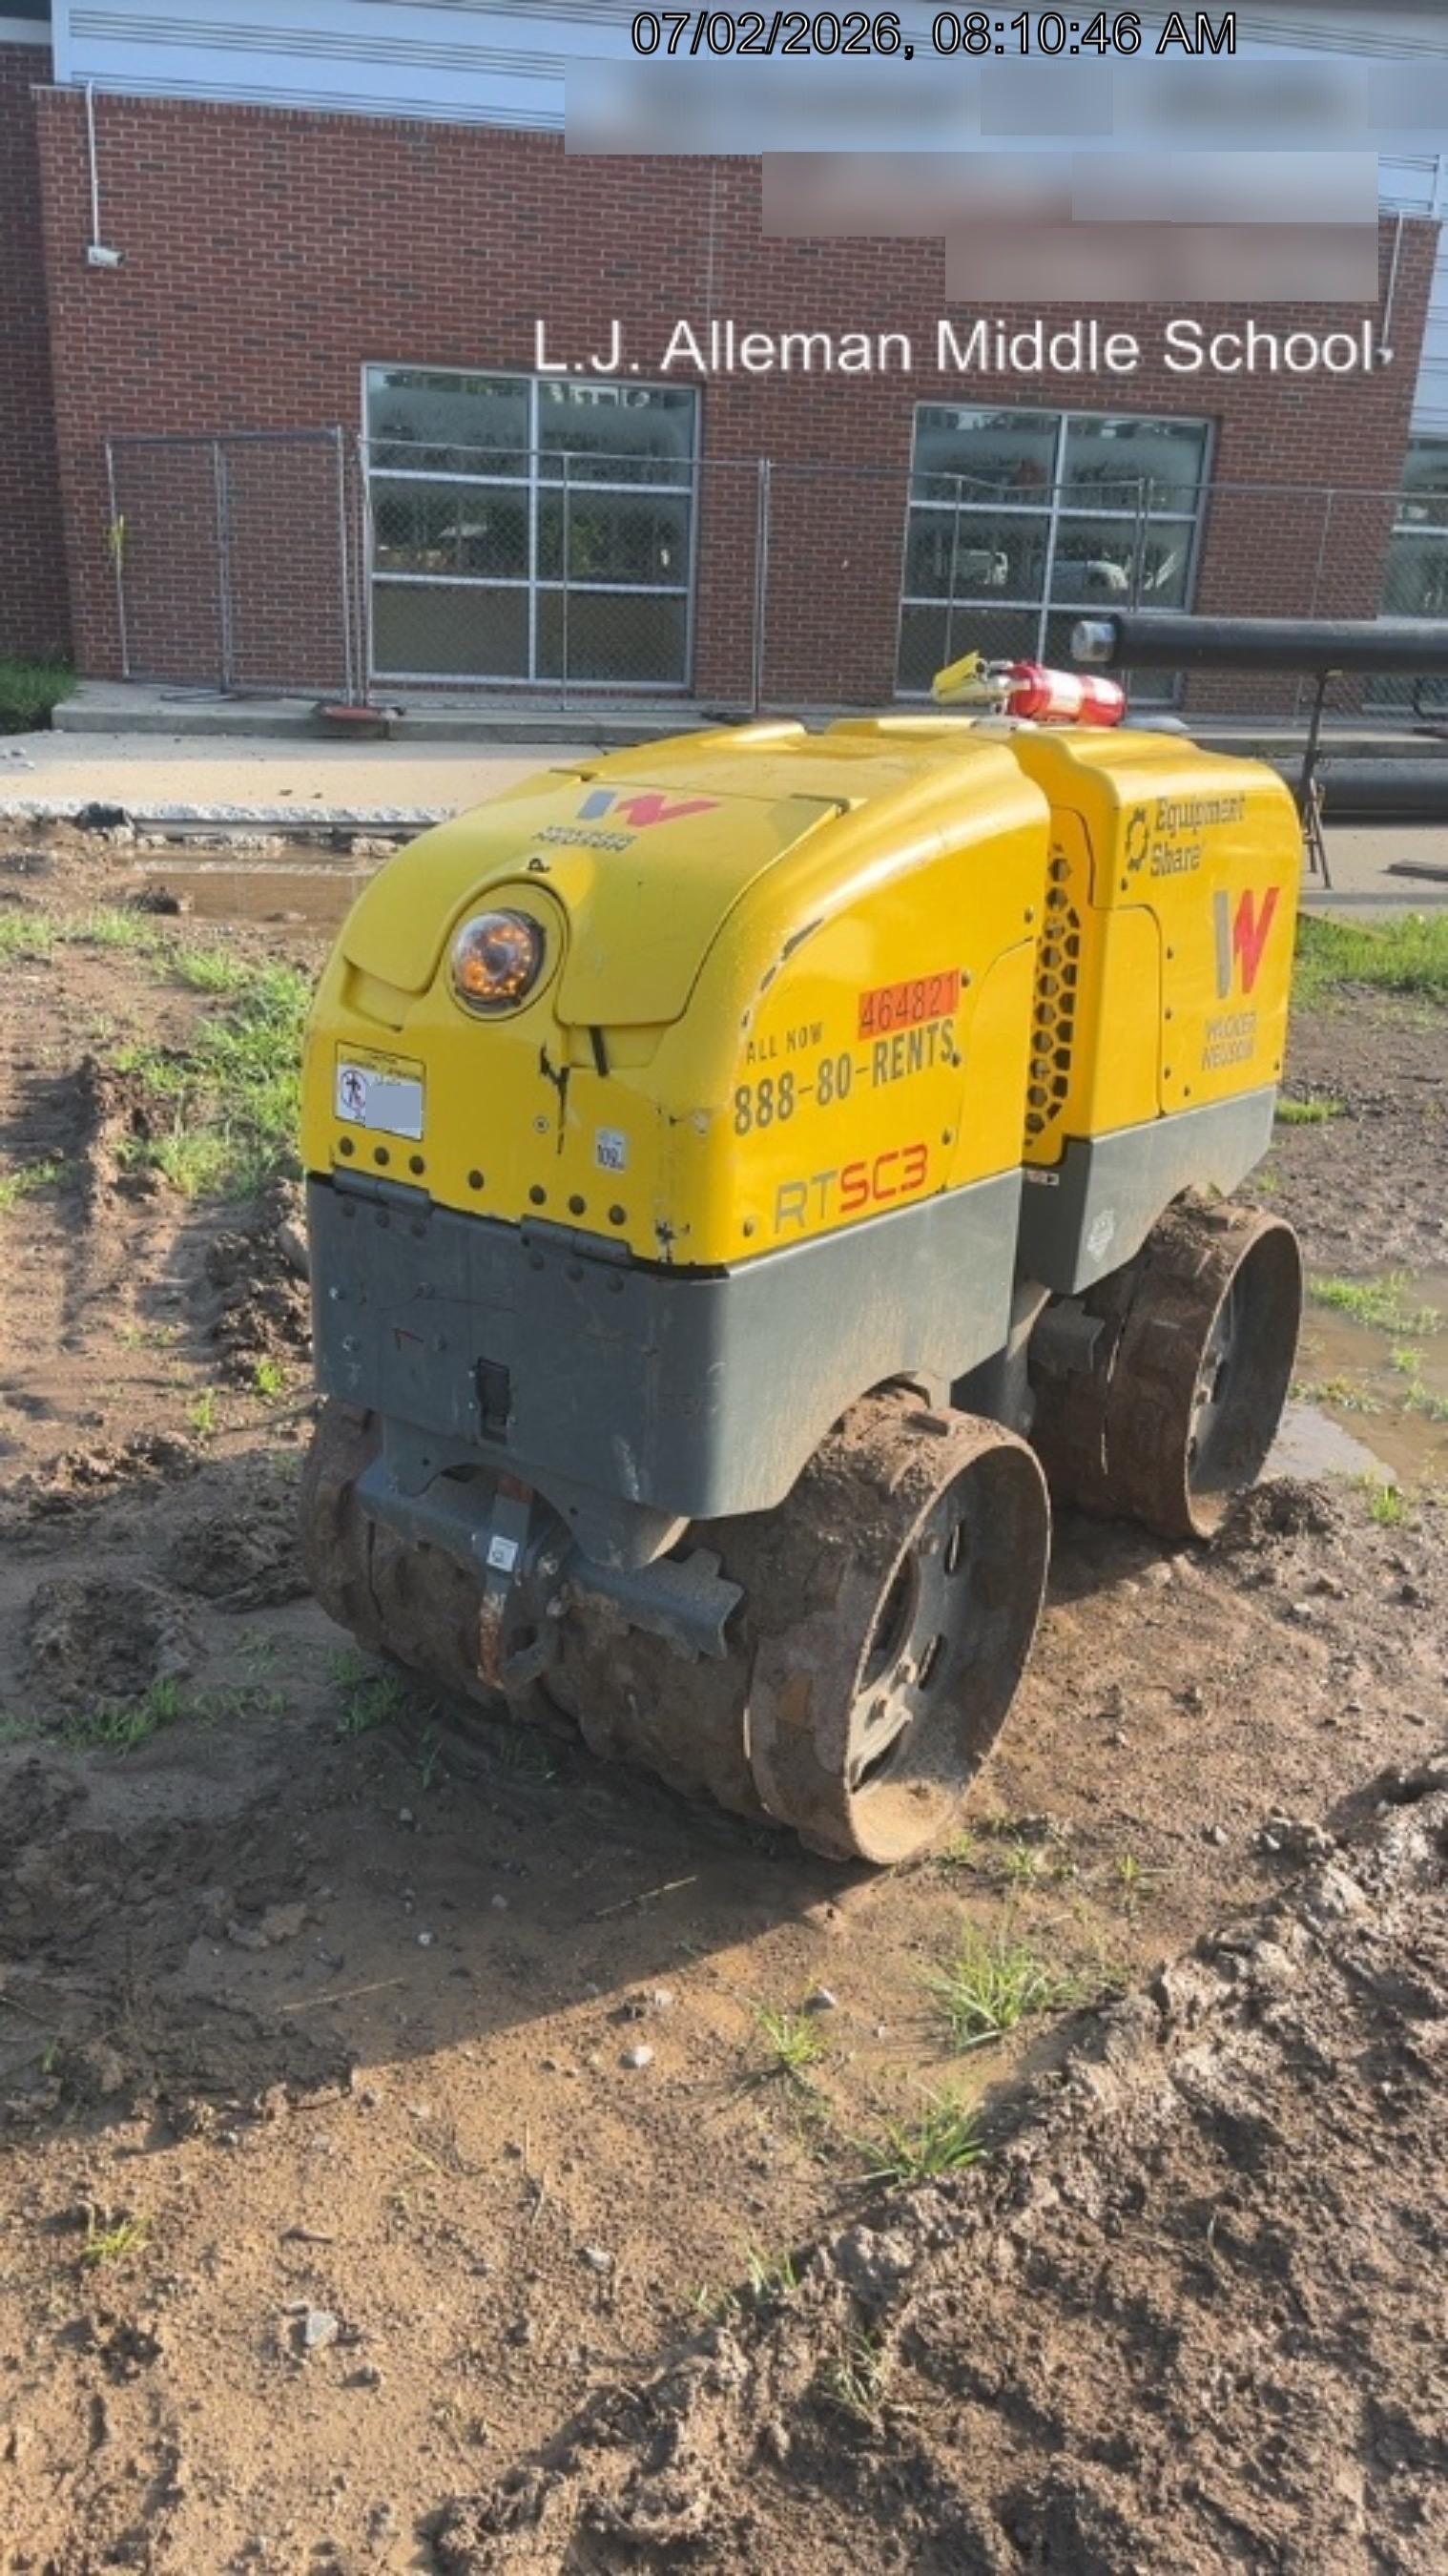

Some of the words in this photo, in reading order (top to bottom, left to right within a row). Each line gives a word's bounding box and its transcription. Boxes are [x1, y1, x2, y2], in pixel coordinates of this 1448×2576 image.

[1155, 795, 1246, 839] Equipment
[1150, 841, 1201, 877] Share
[859, 974, 956, 1034] 464821
